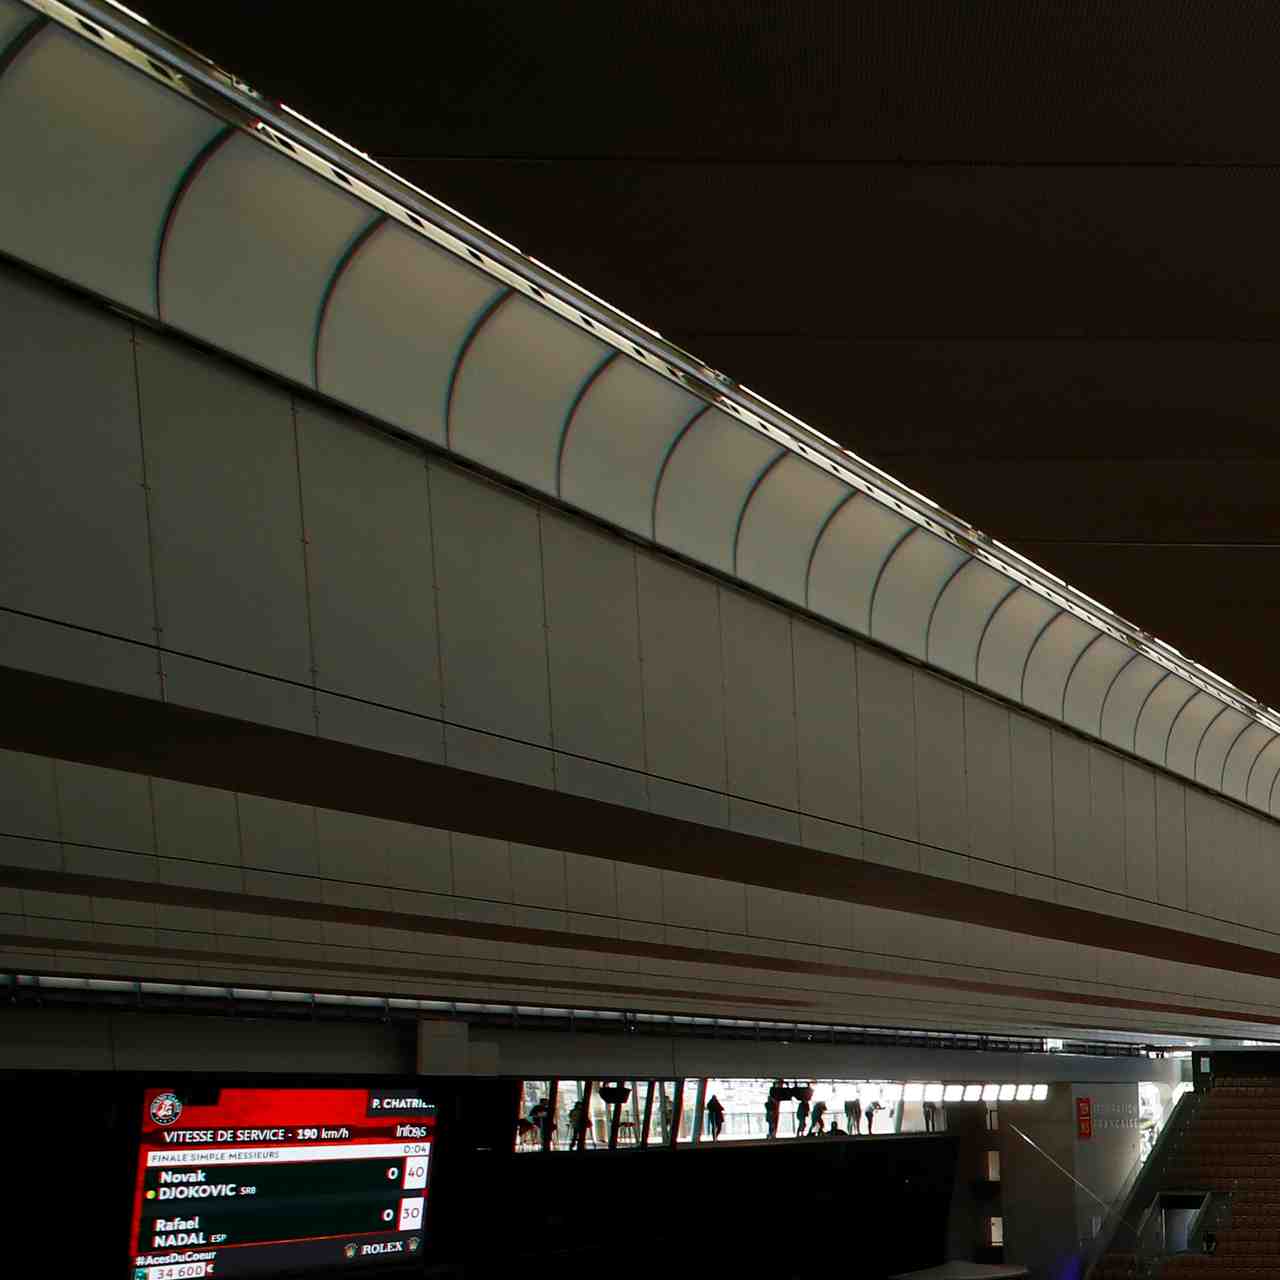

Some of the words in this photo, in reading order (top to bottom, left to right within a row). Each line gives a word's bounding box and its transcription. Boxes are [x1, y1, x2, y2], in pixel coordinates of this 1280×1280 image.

[372, 1099, 381, 1108] P.
[164, 1130, 213, 1142] VITESSE
[217, 1130, 233, 1142] DE
[237, 1128, 285, 1141] SERVICE
[297, 1128, 317, 1140] 190
[321, 1127, 349, 1139] km/h
[403, 1145, 426, 1154] 0:04
[151, 1153, 188, 1162] FINALE
[191, 1152, 225, 1161] SIMPLE
[229, 1151, 279, 1160] MESSIEURS
[160, 1170, 207, 1183] Novak
[387, 1167, 398, 1180] 0
[408, 1167, 424, 1178] 40
[159, 1184, 236, 1200] DJOKOVIC
[240, 1186, 256, 1195] SRB
[383, 1209, 394, 1221] 0
[402, 1208, 420, 1219] 30
[156, 1216, 199, 1232] Rafael
[153, 1232, 207, 1248] NADAL
[211, 1234, 227, 1242] ESP
[362, 1241, 404, 1255] ROLEX
[136, 1251, 217, 1266] #AcesDuCoeur
